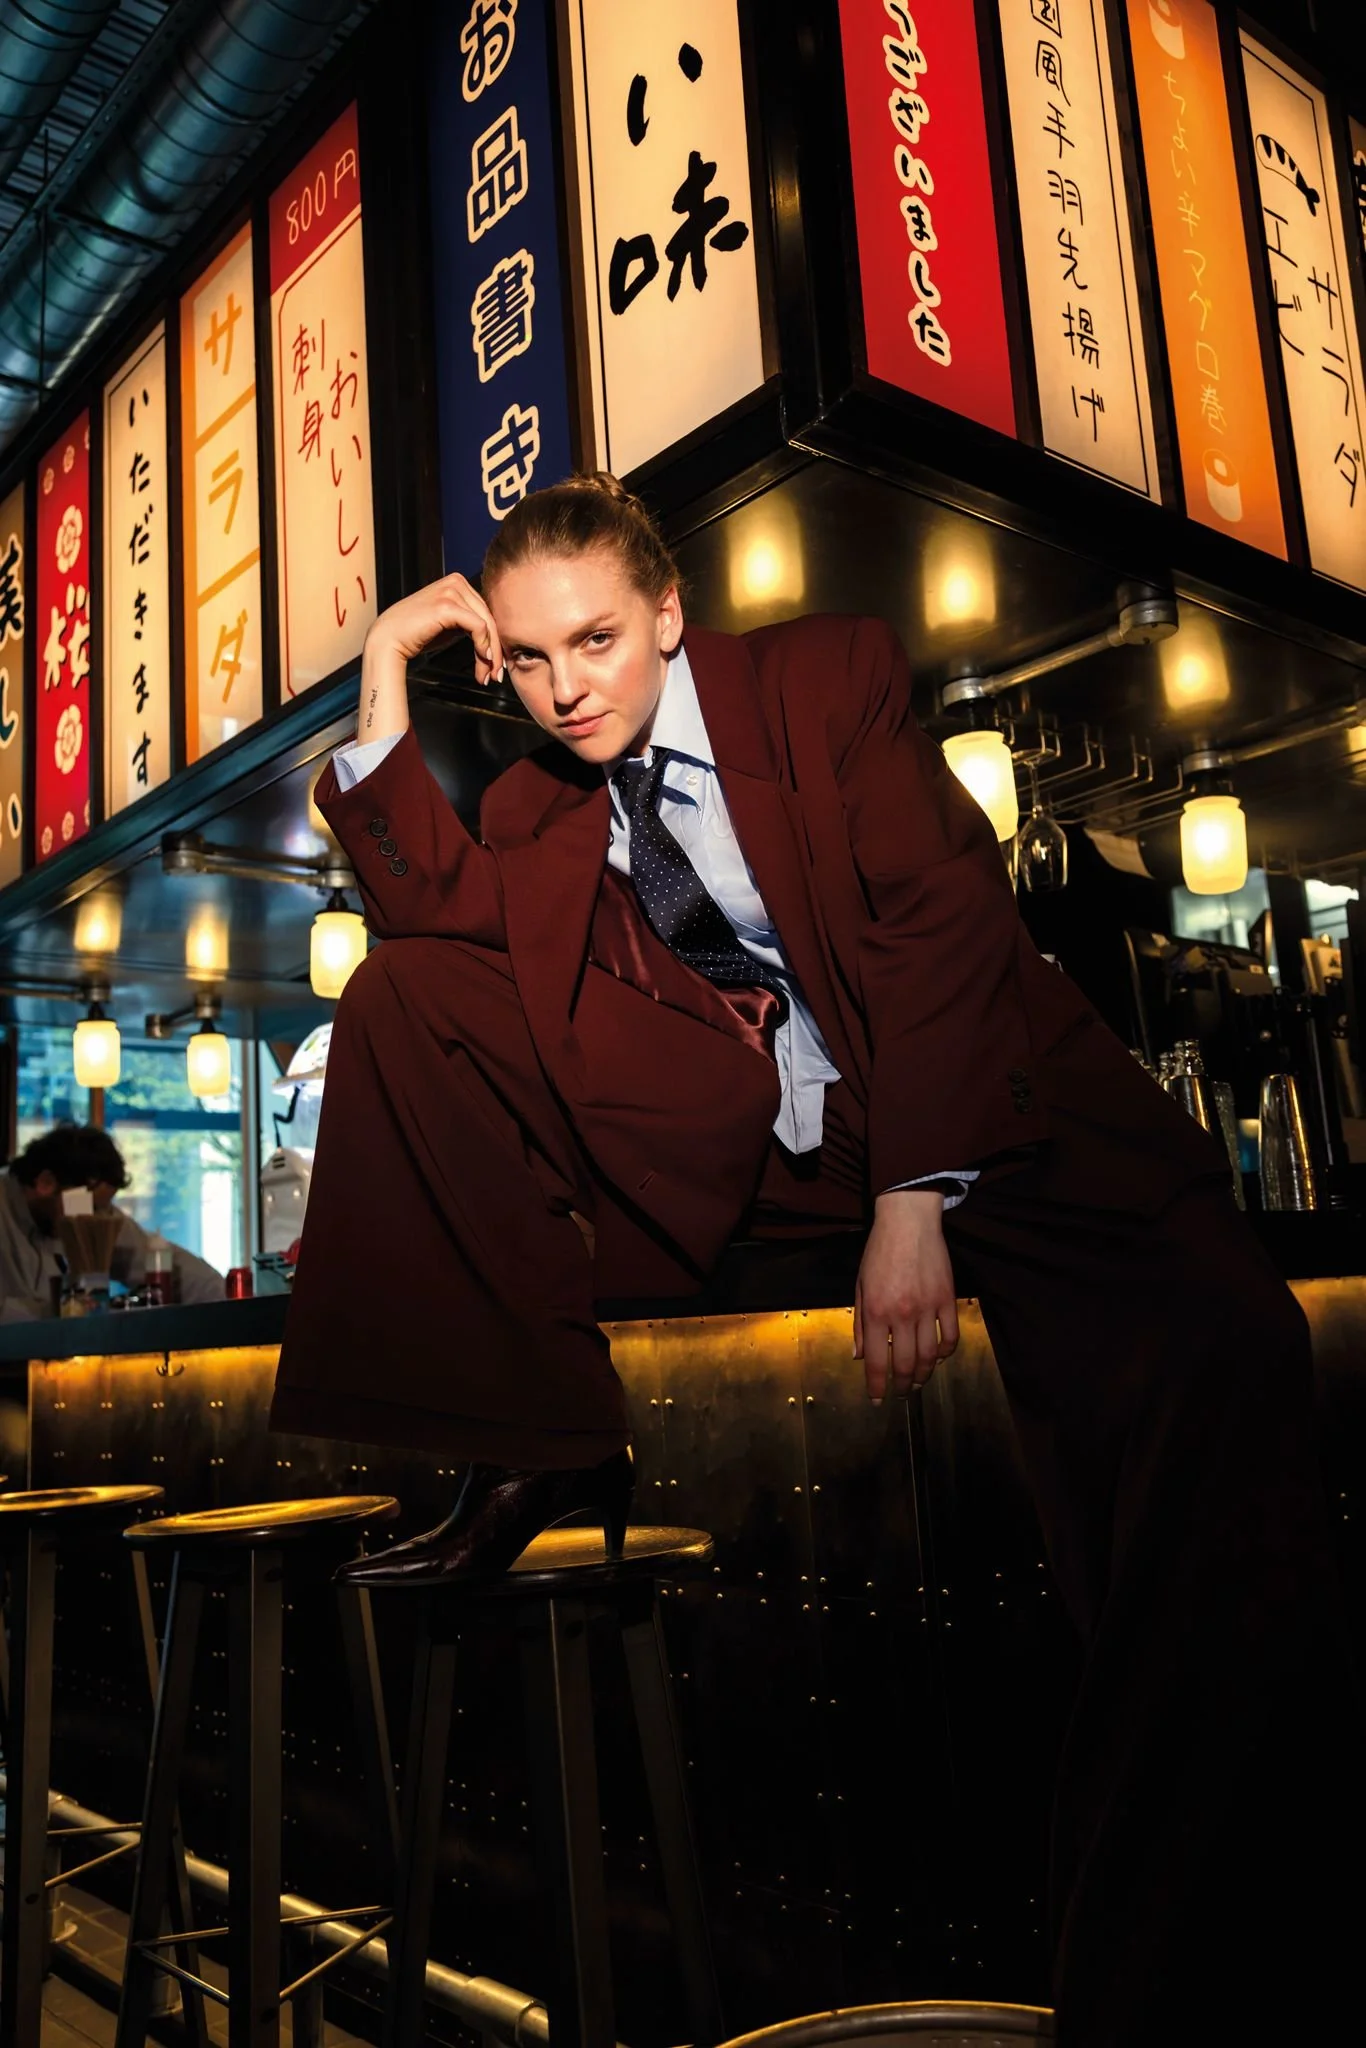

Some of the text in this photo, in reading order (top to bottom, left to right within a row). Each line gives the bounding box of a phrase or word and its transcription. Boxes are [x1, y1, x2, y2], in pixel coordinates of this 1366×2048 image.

[291, 319, 326, 463] 刺身
[460, 0, 540, 521] お品書き
[129, 388, 154, 787] いただきます
[204, 291, 250, 704] サラダ
[329, 350, 368, 628] おいしい
